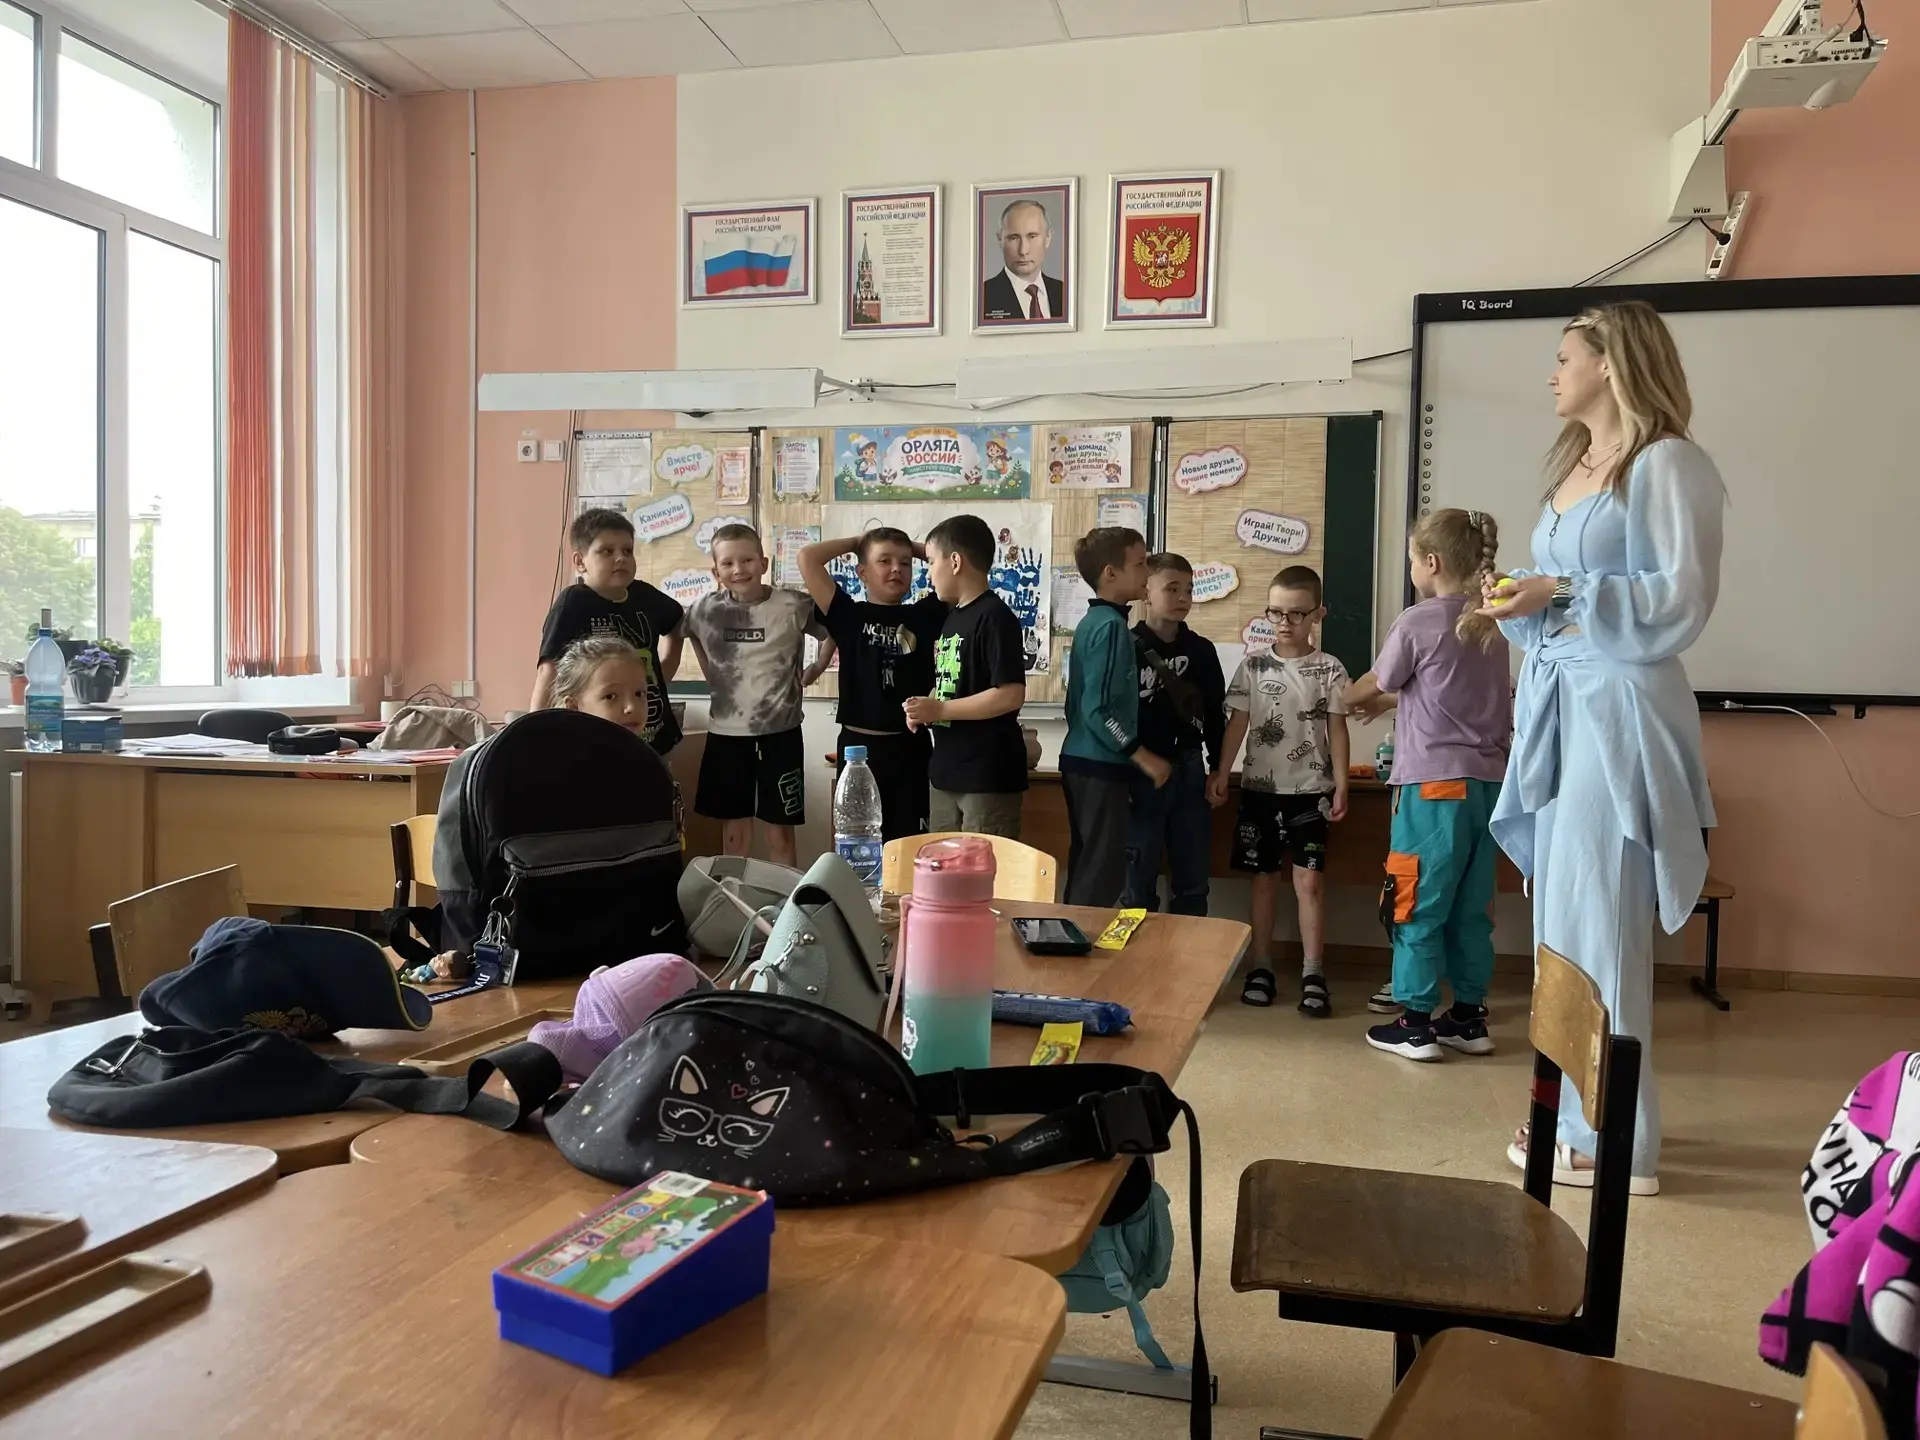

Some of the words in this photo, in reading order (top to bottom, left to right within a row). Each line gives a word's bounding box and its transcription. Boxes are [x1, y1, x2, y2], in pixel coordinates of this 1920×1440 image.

[1126, 189, 1186, 200] ГОСУДАРСТВЕННЫЙ
[1187, 190, 1202, 198] ГЕРБ
[856, 201, 909, 212] ГОСУДАРСТВЕННЫЙ
[1125, 200, 1165, 210] РОССИЙСКОЙ
[1165, 200, 1202, 209] ФЕДЕРАЦИИ
[856, 212, 892, 222] РОССИЙСКОЙ
[893, 211, 927, 220] ФЕДЕРАЦИИ
[1479, 299, 1513, 309] Board
[901, 440, 960, 454] ОРЛЯТА
[1064, 445, 1077, 453] Мы
[1078, 444, 1108, 452] команда,
[667, 452, 703, 466] Вместе
[905, 453, 957, 466] РОССИИ
[1181, 464, 1208, 475] Новые
[1209, 457, 1235, 470] друзья
[673, 461, 700, 476] ярче!
[1181, 473, 1209, 485] лучшие
[1209, 463, 1244, 477] моменты!
[639, 504, 684, 524] Каникулы
[649, 511, 687, 531] пользой!
[1243, 517, 1275, 531] Играй!
[1276, 523, 1305, 537] Твори!
[1251, 530, 1292, 545] Дружи!
[664, 576, 712, 590] Улыбнись
[1194, 572, 1231, 586] инается
[675, 584, 703, 598] лету!
[1250, 625, 1276, 636] Кажд
[1262, 682, 1282, 694] MOM
